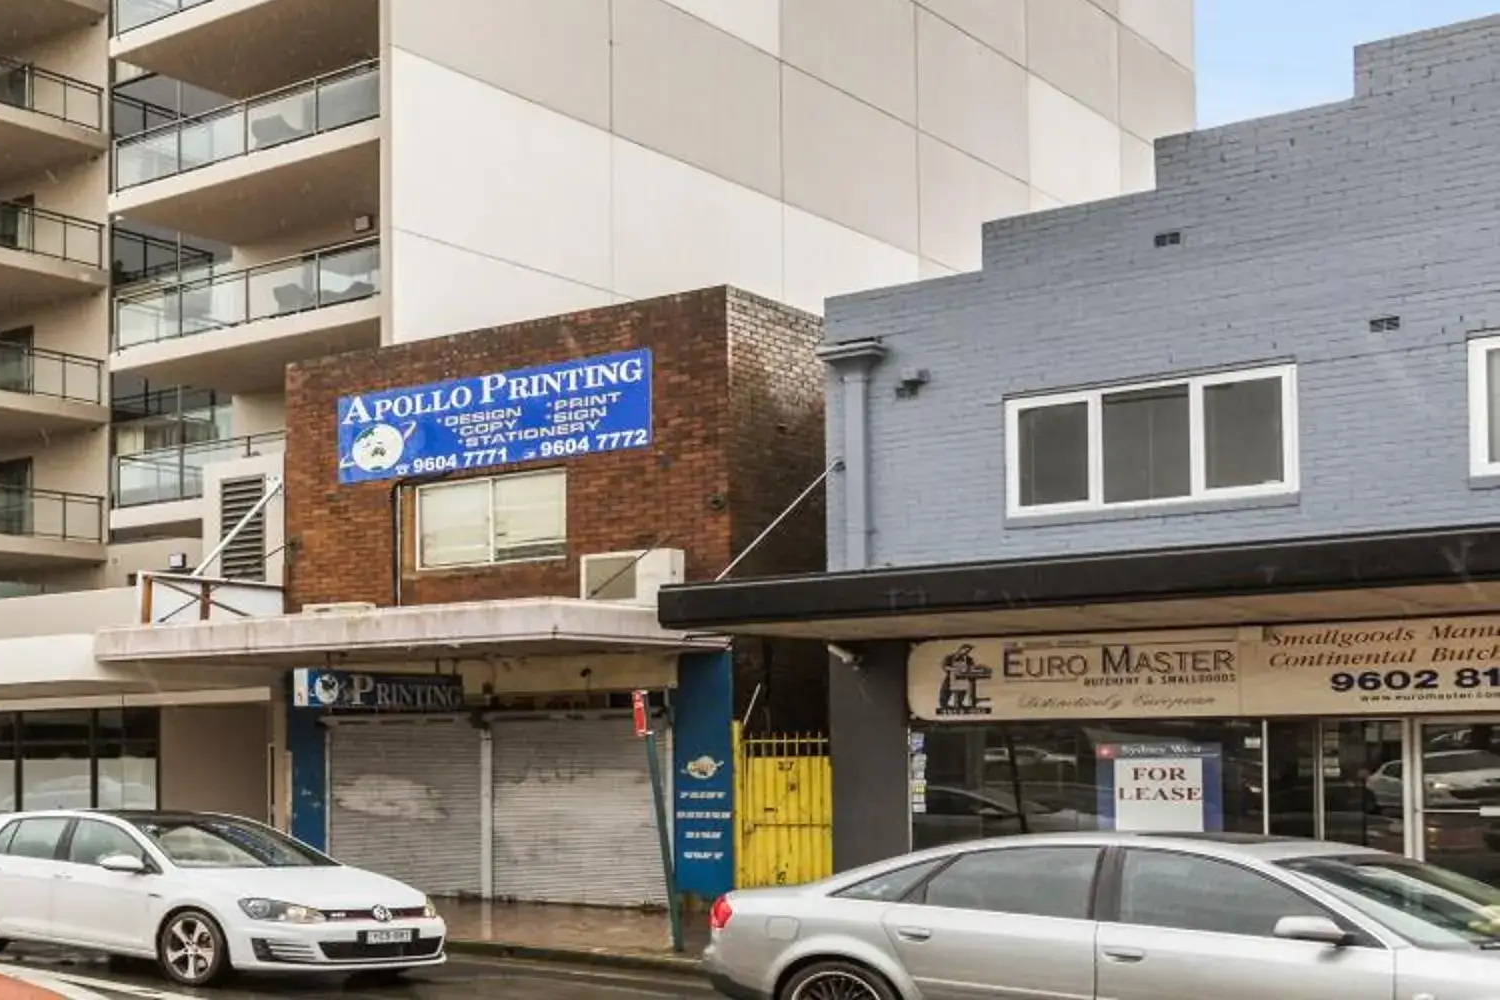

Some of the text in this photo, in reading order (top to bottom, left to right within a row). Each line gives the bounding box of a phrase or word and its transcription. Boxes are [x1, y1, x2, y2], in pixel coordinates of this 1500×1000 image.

[342, 358, 643, 425] APOLLO PRINTING
[554, 391, 621, 411] PRINT
[444, 406, 522, 428] DESIGN
[553, 406, 607, 424] SIGN
[459, 419, 518, 437] COPY
[465, 421, 600, 449] STATIONERY
[541, 429, 648, 457] 9604 7772
[413, 447, 508, 473] 9604 7771
[1269, 626, 1416, 648] Smallgoods
[1003, 645, 1236, 678] EURO MASTER
[1268, 648, 1417, 668] Continental
[1084, 676, 1140, 687] BUTCHERY
[1161, 673, 1237, 685] SMALLGOODS
[1329, 668, 1440, 693] 9602
[351, 674, 462, 709] PRINTING
[1132, 766, 1188, 782] FOR
[1119, 787, 1201, 801] LEASE
